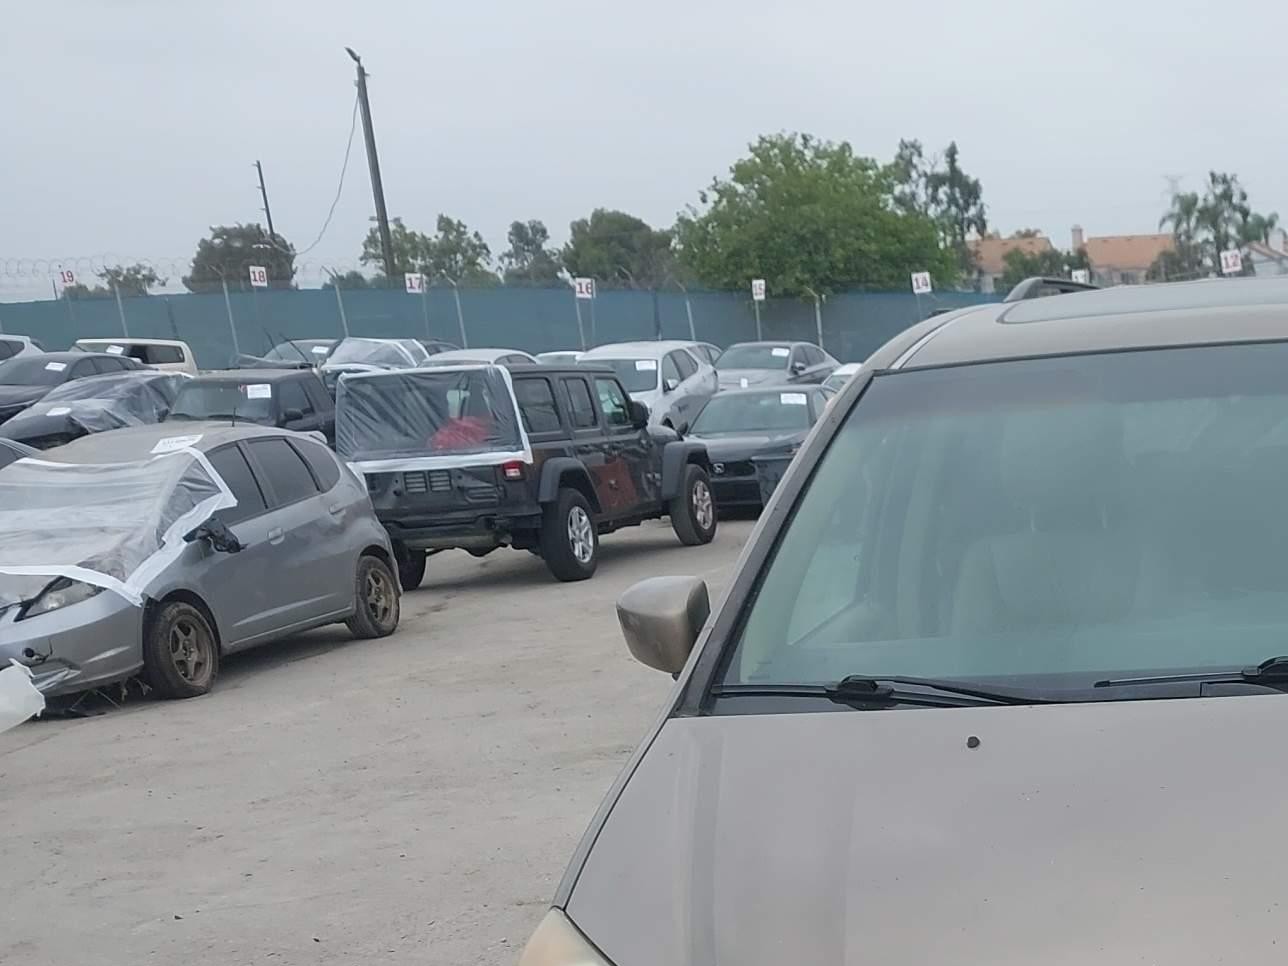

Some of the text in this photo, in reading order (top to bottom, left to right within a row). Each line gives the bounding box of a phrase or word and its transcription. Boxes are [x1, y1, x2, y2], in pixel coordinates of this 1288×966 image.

[1223, 255, 1240, 268] 12
[60, 270, 74, 284] 19
[251, 270, 266, 283] 18
[914, 276, 928, 290] 14
[407, 278, 422, 291] 17
